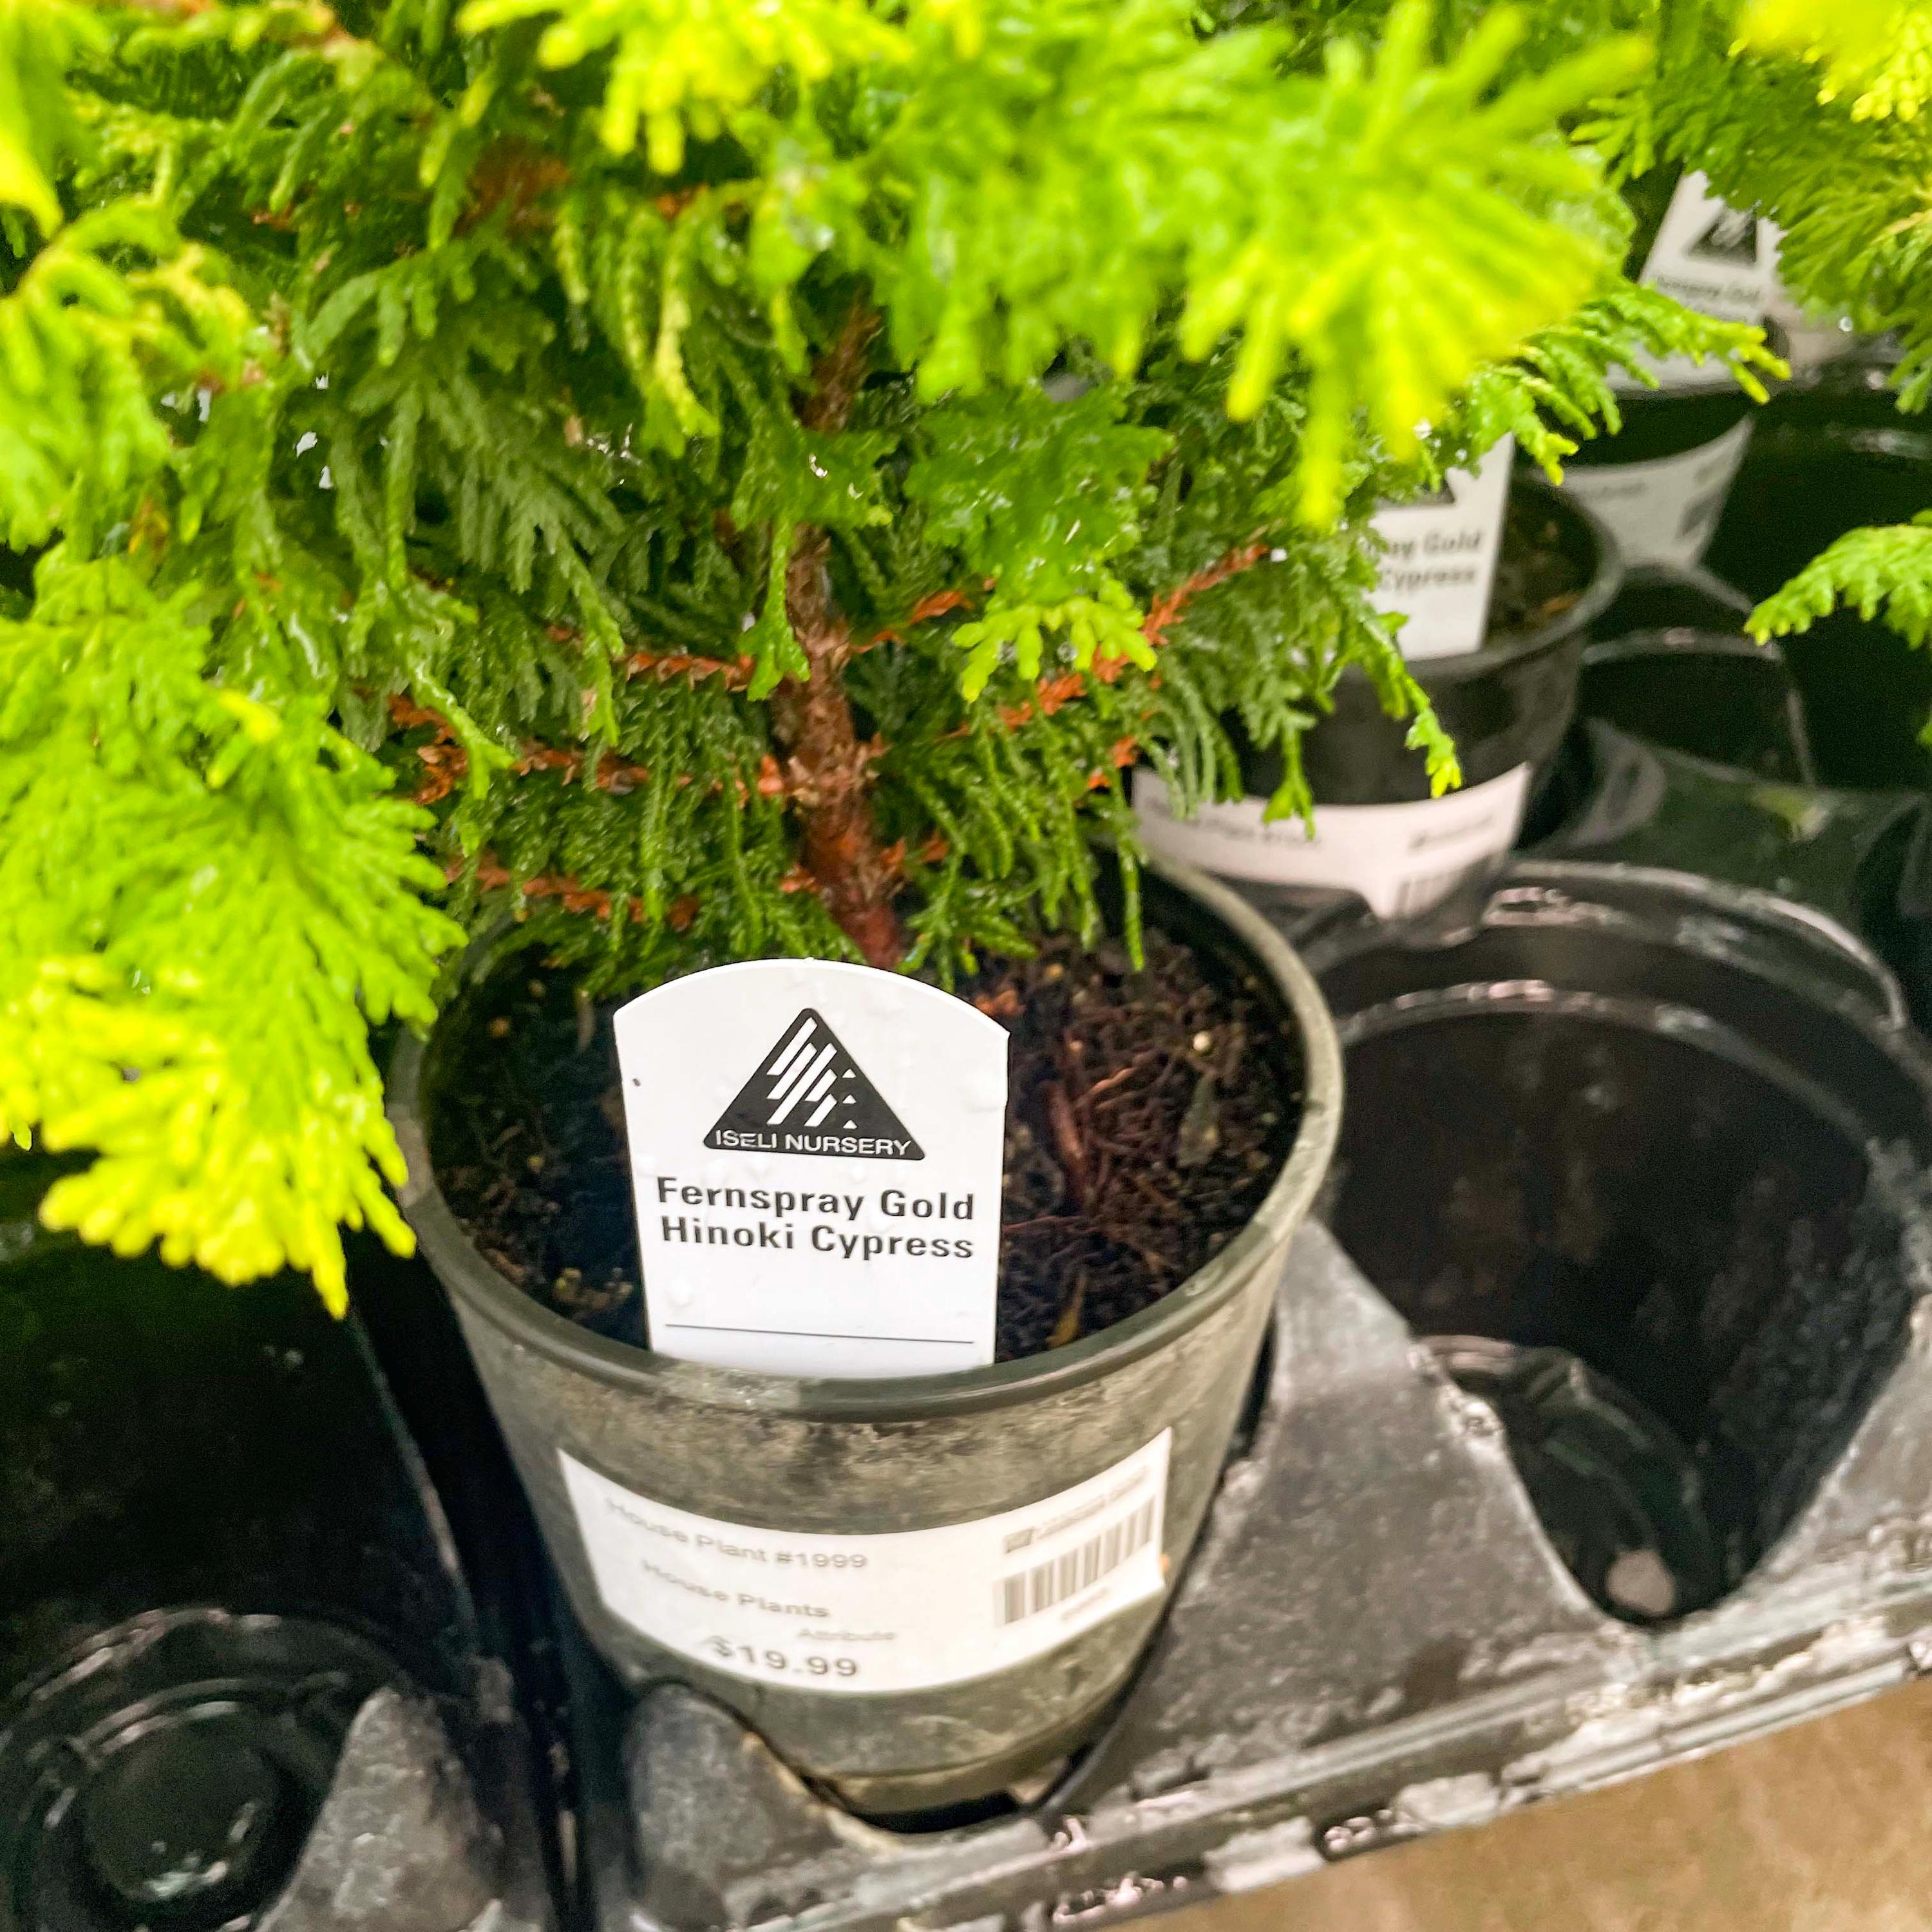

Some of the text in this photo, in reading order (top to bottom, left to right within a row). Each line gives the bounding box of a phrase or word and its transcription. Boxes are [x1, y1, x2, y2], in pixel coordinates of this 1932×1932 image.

[715, 1130, 912, 1155] ISELI NURSERY
[657, 1176, 974, 1221] Fernspray Gold
[661, 1215, 974, 1260] Hinoki Cypress
[607, 1496, 867, 1569] House Plant #1999
[641, 1558, 829, 1618] House Plants
[703, 1634, 858, 1677] $19.99
